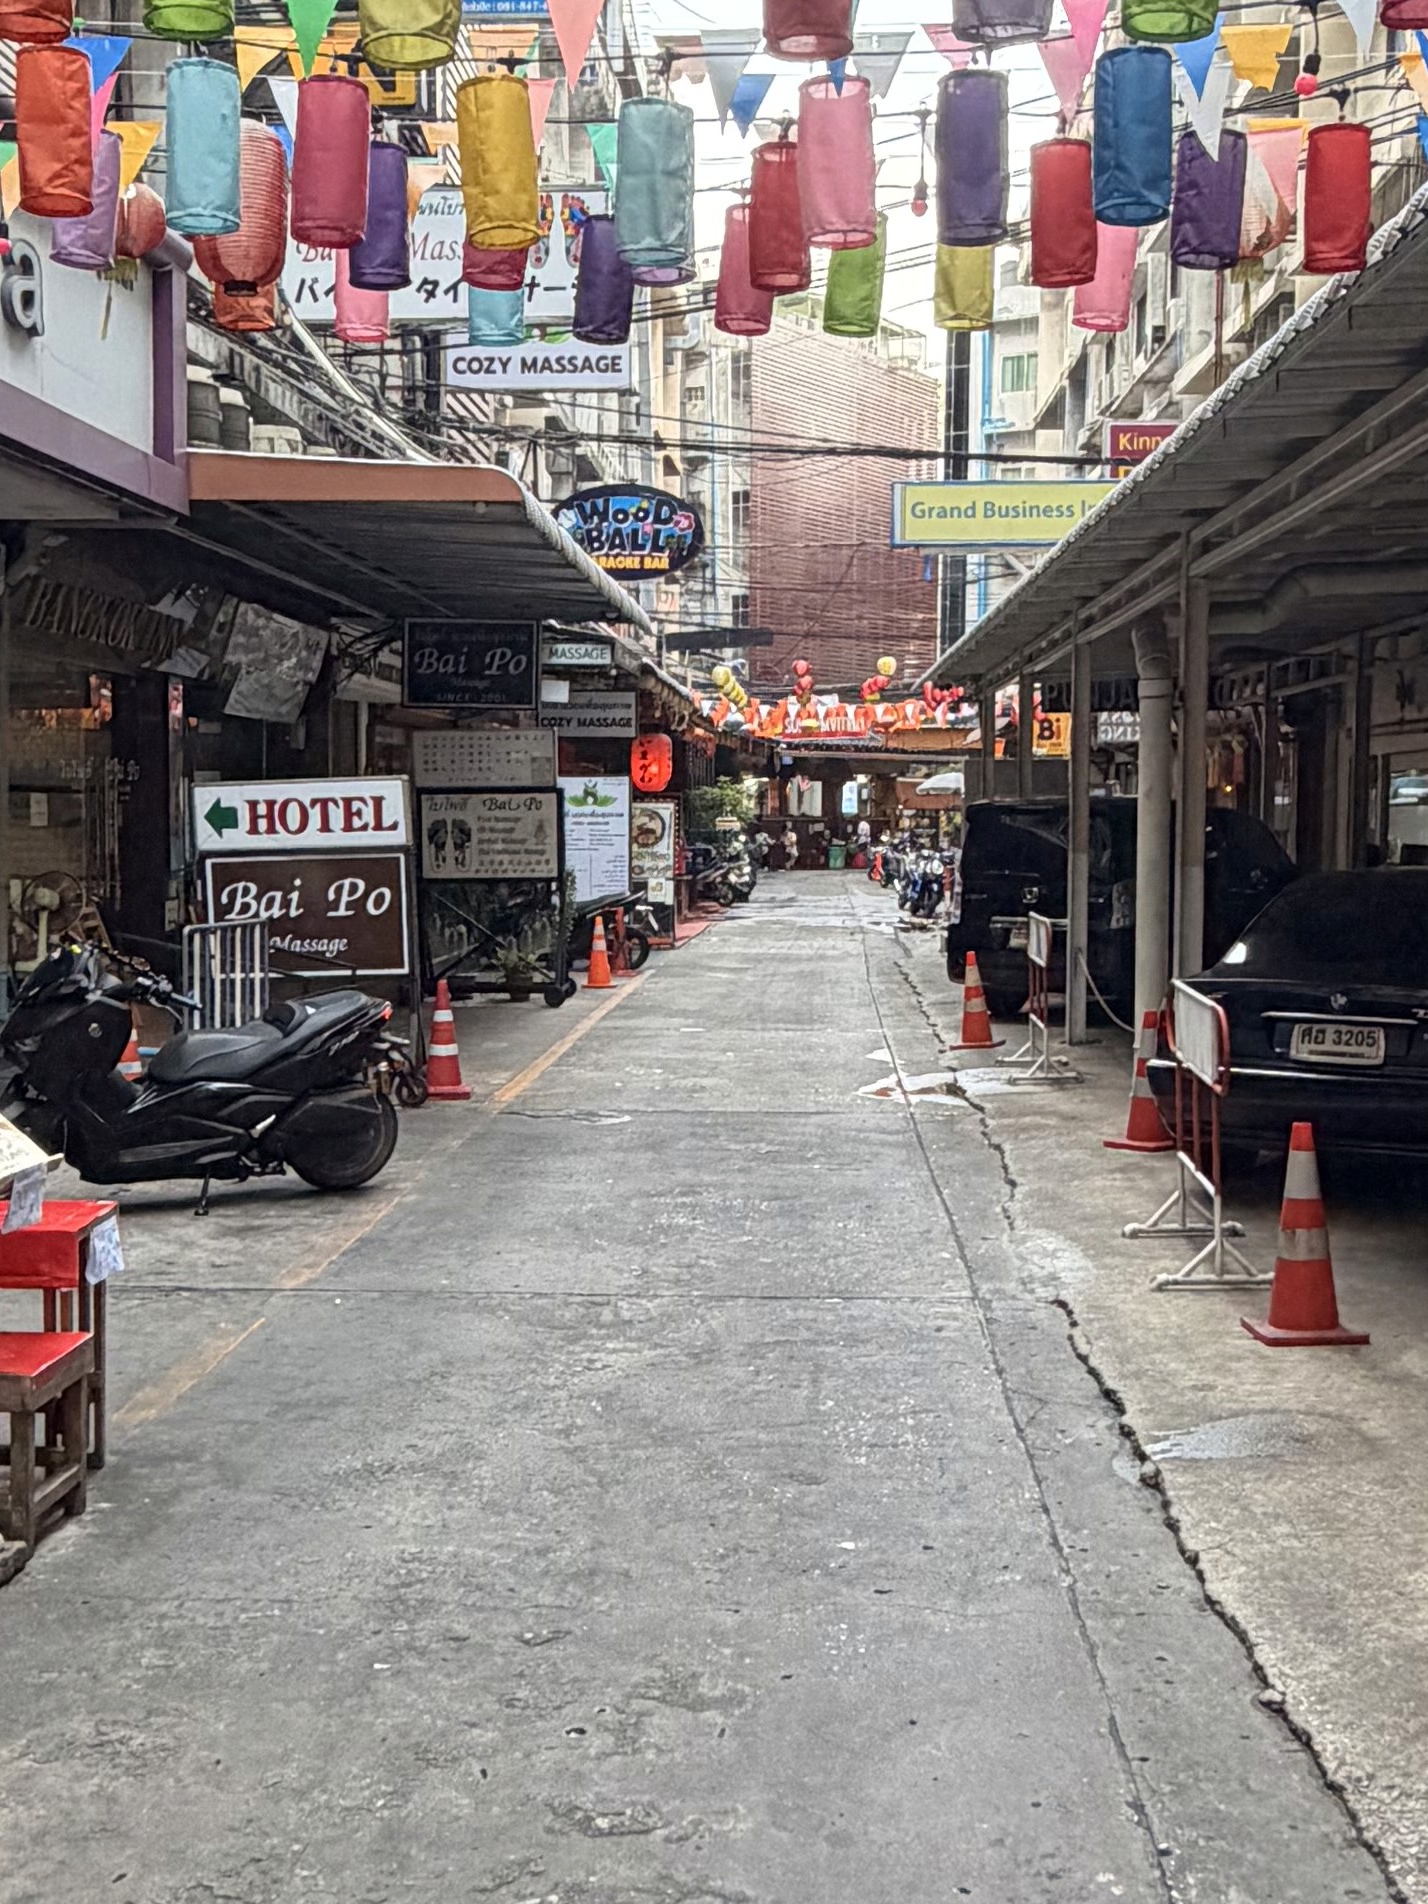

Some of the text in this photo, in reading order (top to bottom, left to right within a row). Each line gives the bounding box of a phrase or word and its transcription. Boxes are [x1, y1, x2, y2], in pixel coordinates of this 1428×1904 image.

[452, 354, 623, 375] COZY MASSAGE
[1119, 432, 1163, 451] Kinn
[910, 500, 977, 519] Grand
[983, 500, 1075, 519] Business
[593, 556, 670, 569] RAOKE BAR
[413, 645, 528, 676] Bai Po
[548, 647, 608, 660] MASSAGE
[542, 717, 633, 728] COZY MASSAGE
[523, 797, 543, 812] Po
[244, 794, 400, 837] HOTEL
[220, 876, 392, 919] Bai Po
[269, 934, 349, 958] Massage
[1333, 1029, 1377, 1048] 3205
